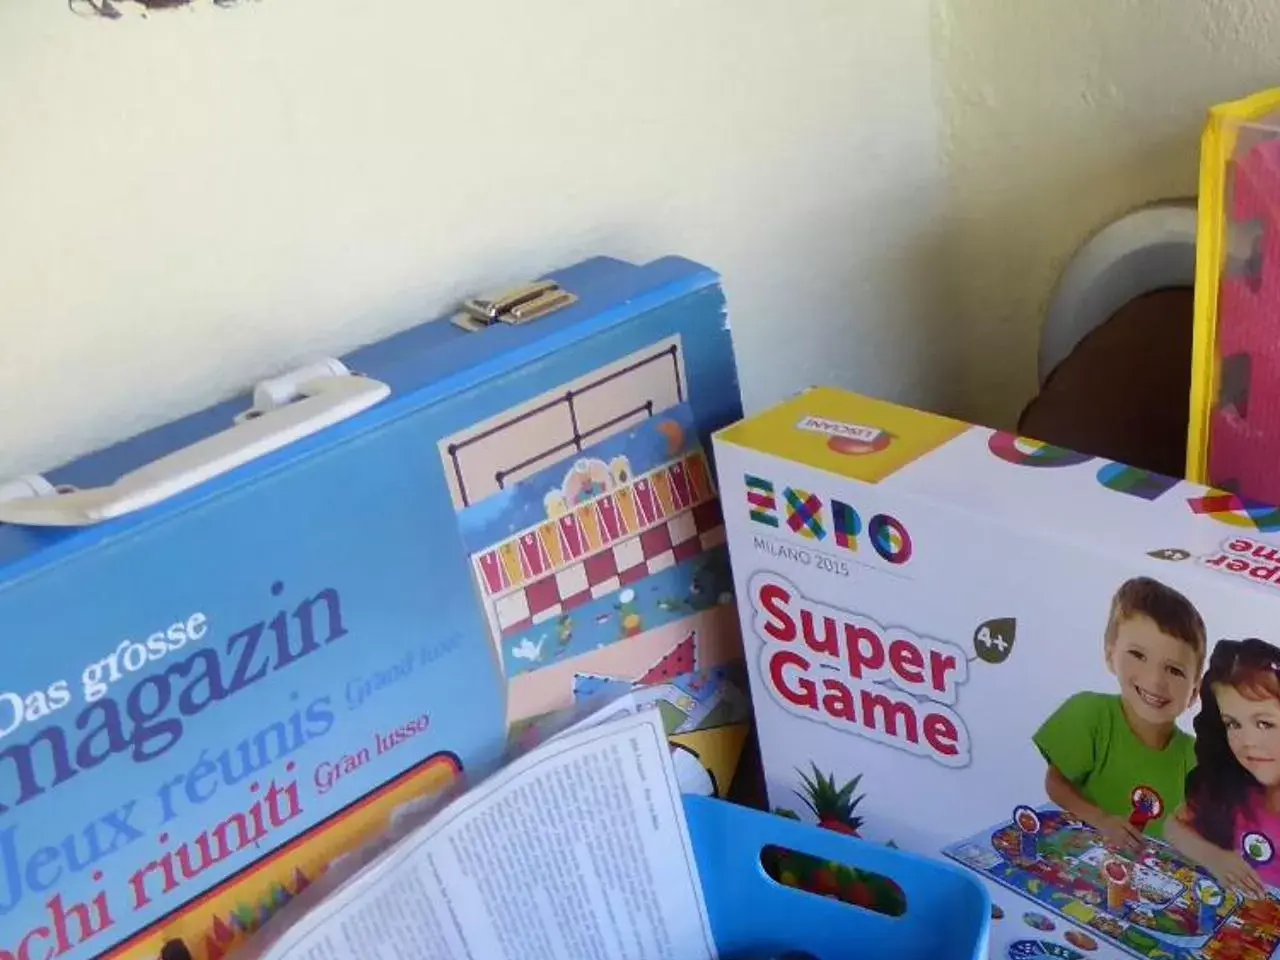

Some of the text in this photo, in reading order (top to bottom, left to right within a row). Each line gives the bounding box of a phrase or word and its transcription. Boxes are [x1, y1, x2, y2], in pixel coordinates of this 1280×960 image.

[744, 473, 913, 565] EXPO
[753, 536, 850, 579] MILANO 2015
[82, 611, 208, 702] grosse
[759, 583, 956, 693] Super
[977, 626, 1009, 652] 4+
[0, 580, 348, 812] magazin
[769, 650, 959, 755] Game
[0, 798, 143, 915] Jeux
[151, 690, 336, 825] réunis
[344, 650, 415, 710] Grand
[128, 761, 304, 912] riuniti
[313, 747, 370, 795] Gran
[375, 713, 431, 756] lusso
